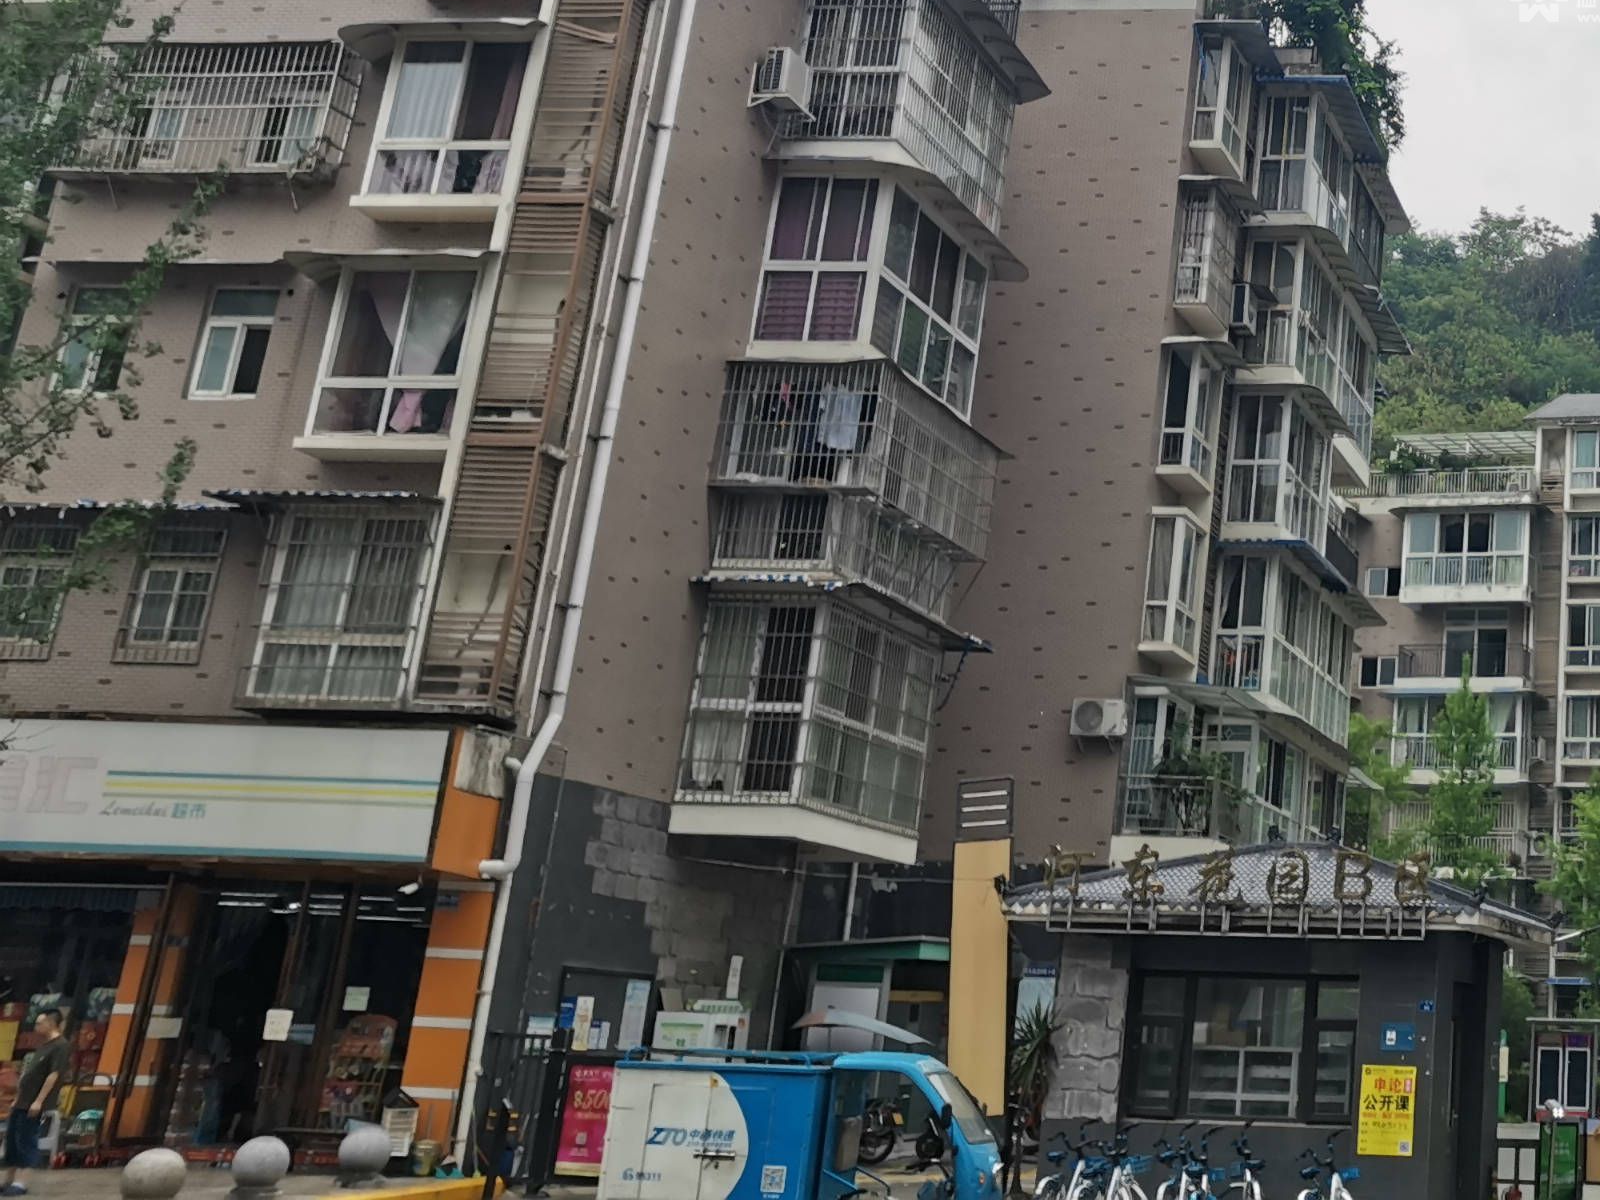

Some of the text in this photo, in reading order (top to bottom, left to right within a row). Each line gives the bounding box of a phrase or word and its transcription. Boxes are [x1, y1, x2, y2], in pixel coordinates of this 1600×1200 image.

[1363, 1093, 1410, 1111] 公开课
[647, 1127, 688, 1146] ZTO
